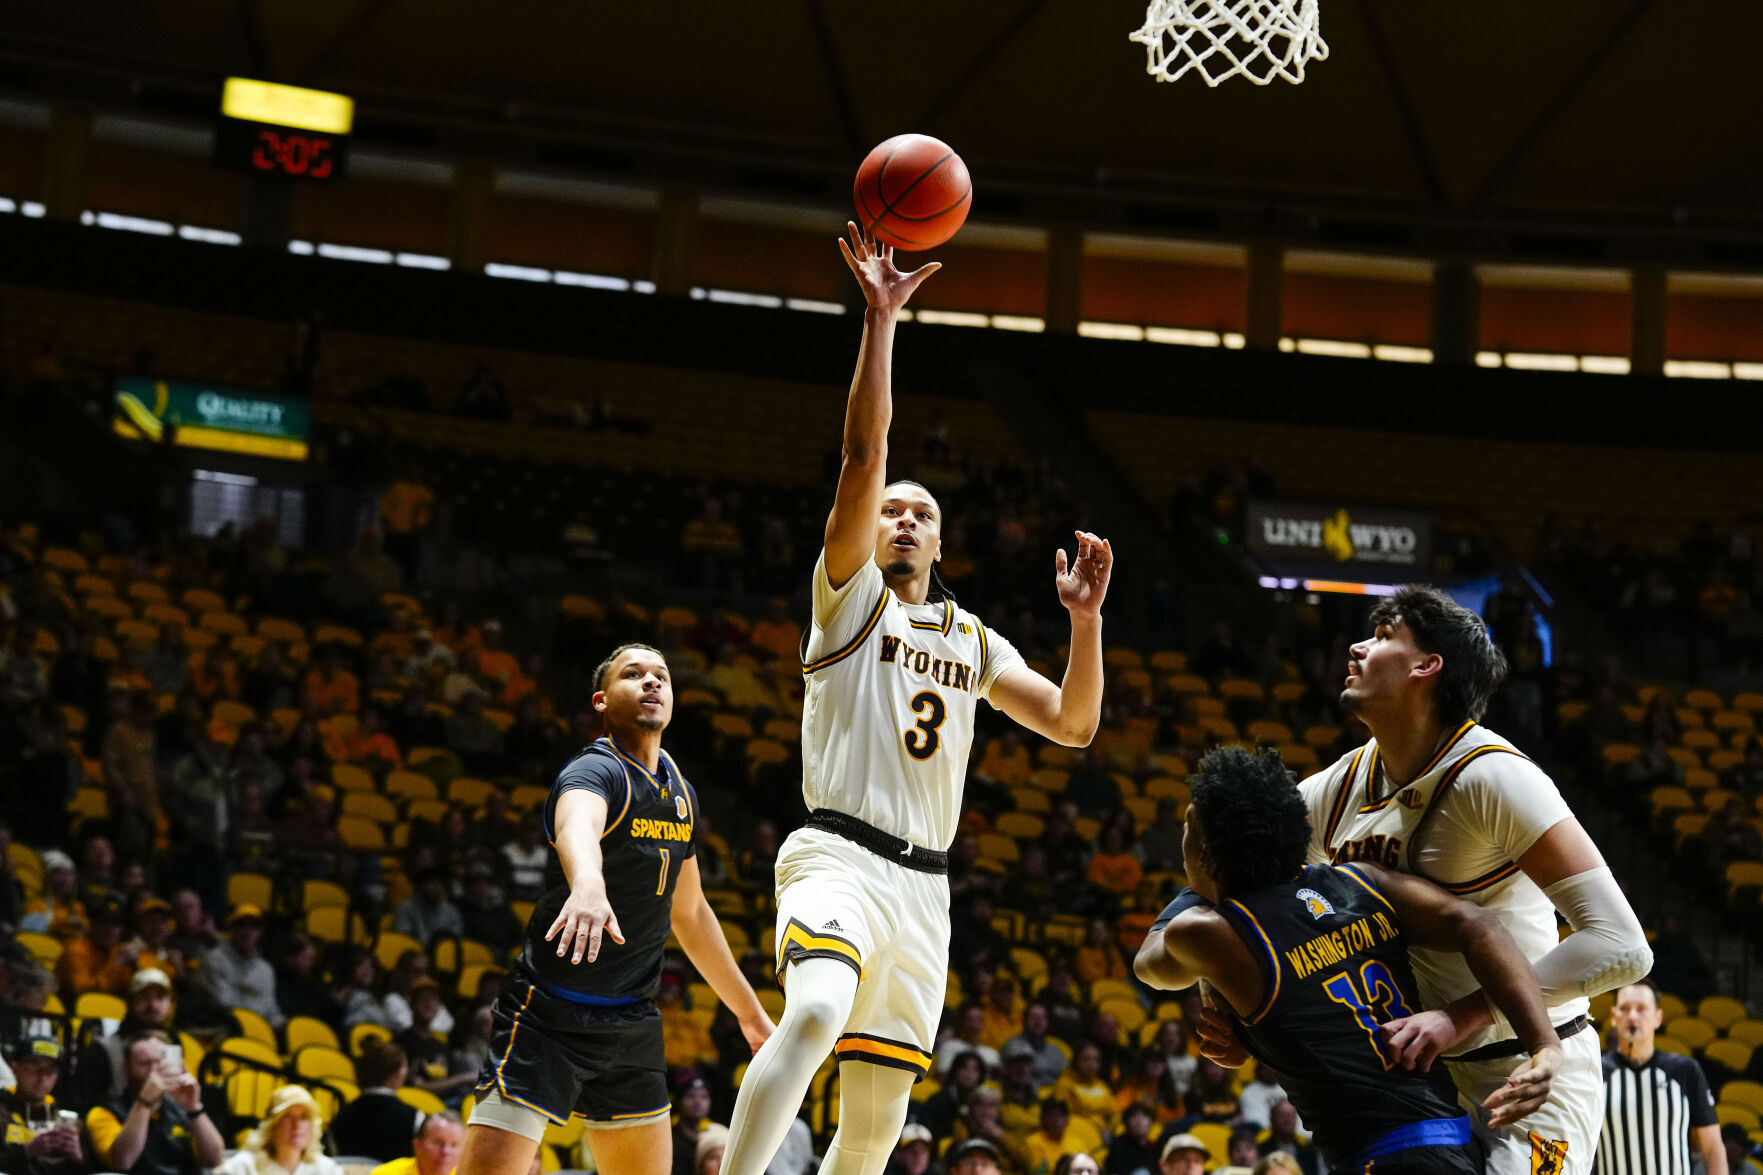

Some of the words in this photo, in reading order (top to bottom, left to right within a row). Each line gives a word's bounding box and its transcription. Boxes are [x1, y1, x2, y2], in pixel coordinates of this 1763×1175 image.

[253, 131, 332, 178] 2:05
[196, 392, 283, 425] QUALITY
[1262, 517, 1322, 548] UNI
[1350, 523, 1417, 553] WYO
[904, 690, 947, 762] 3
[630, 818, 692, 843] SPARTANS
[656, 848, 670, 895] 1
[1285, 917, 1375, 979] WASHINGTON
[1372, 912, 1399, 942] JR.
